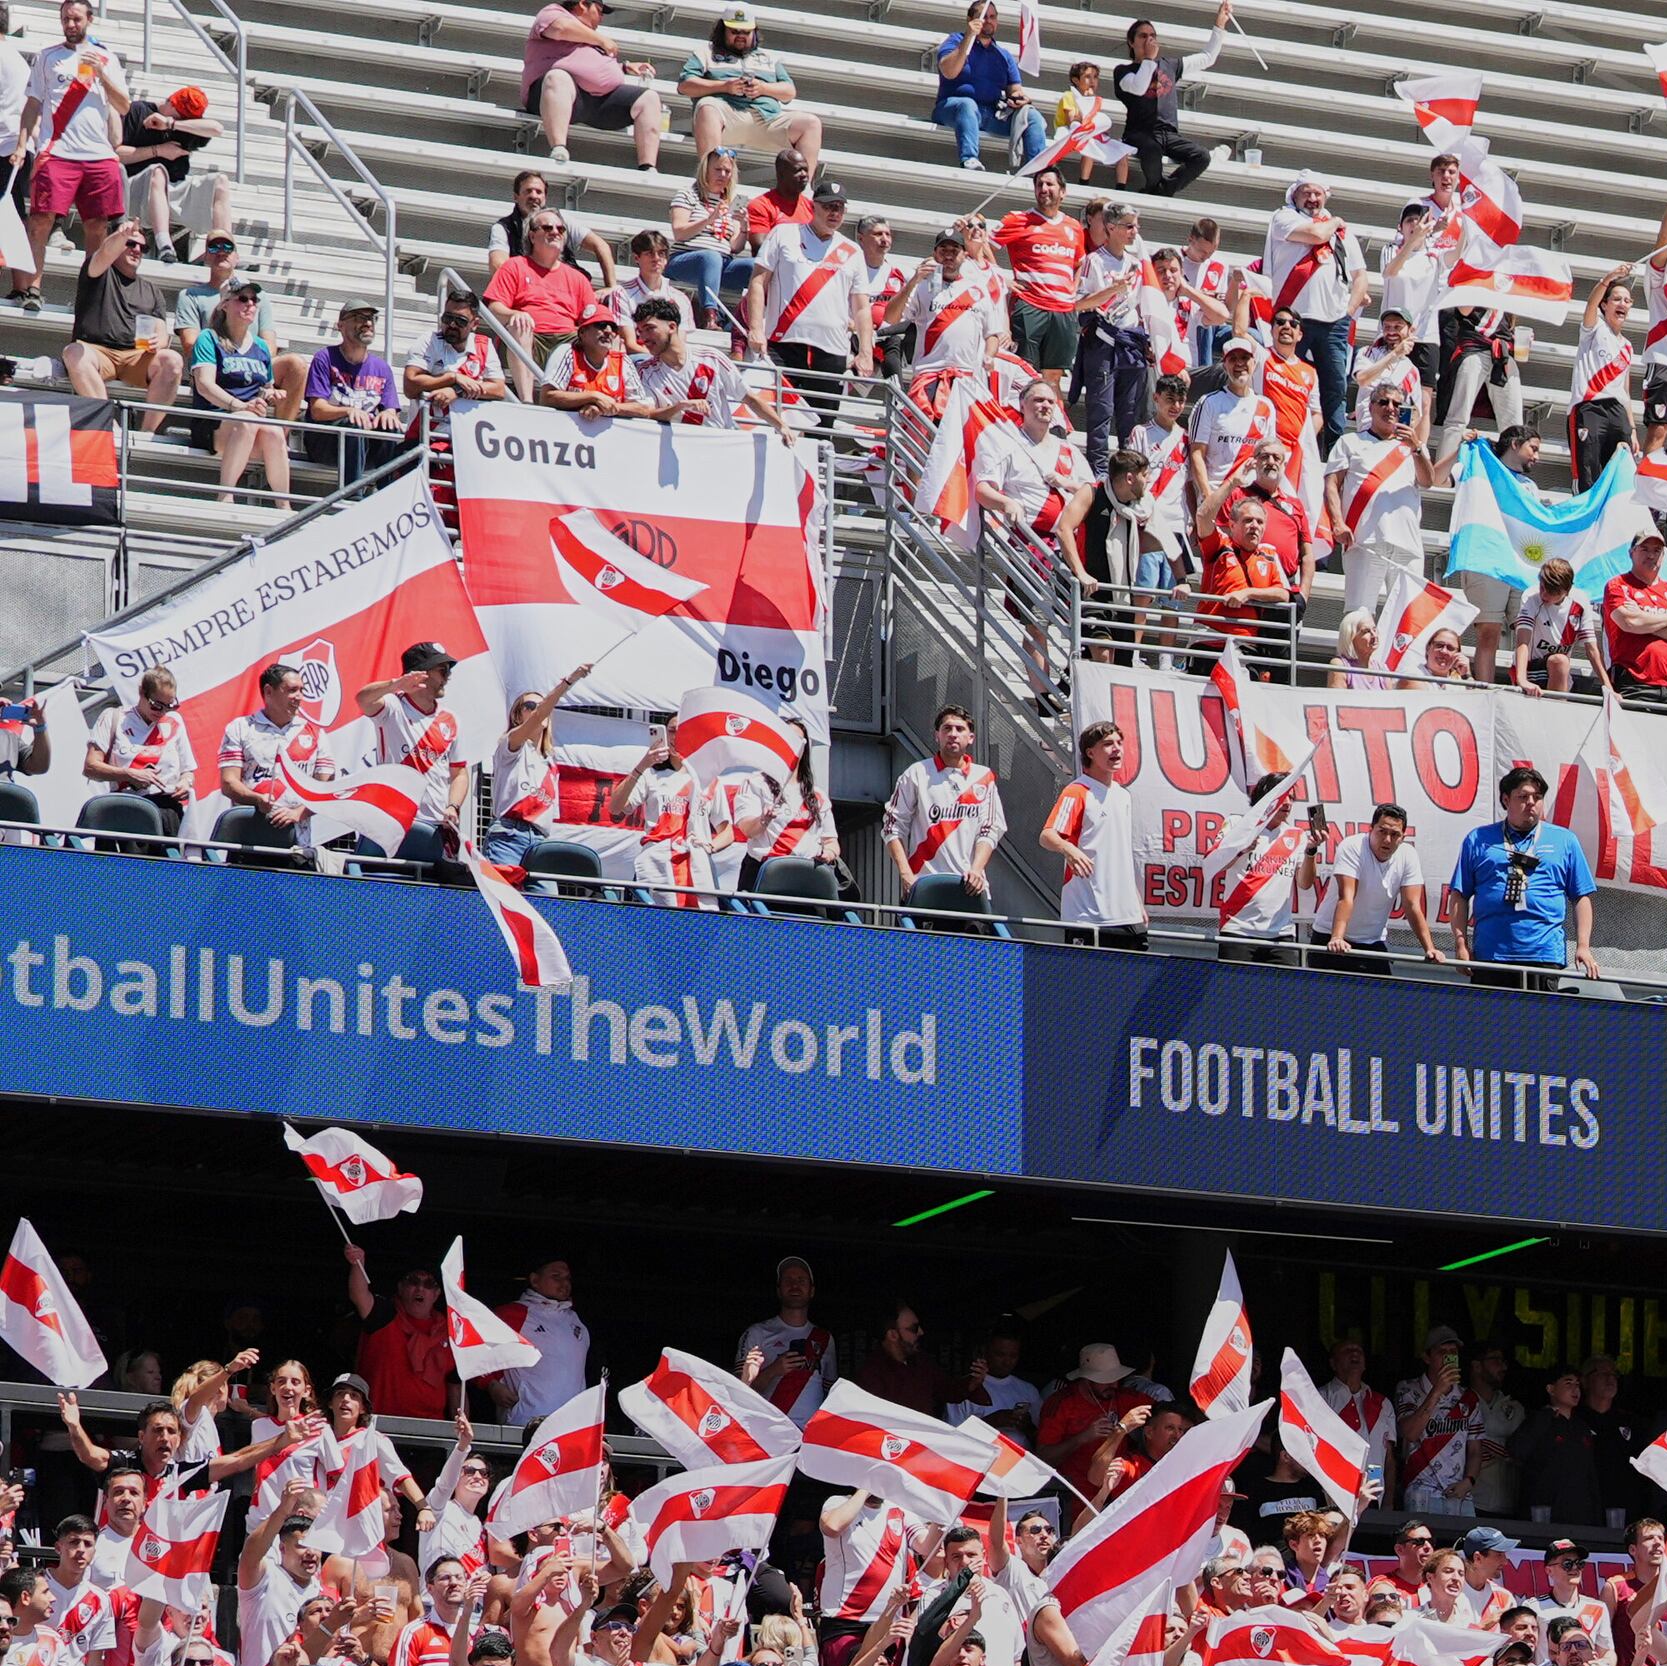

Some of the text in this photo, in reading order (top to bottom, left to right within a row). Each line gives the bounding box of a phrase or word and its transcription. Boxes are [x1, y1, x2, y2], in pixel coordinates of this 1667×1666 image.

[473, 418, 597, 469] Gonza
[257, 499, 432, 624] ESTAREMOS
[114, 597, 255, 679] SIEMPRE
[716, 646, 821, 699] Diego
[930, 802, 980, 824] Quilmes
[1246, 861, 1299, 879] AIRLINES
[1248, 851, 1298, 868] TURKISH
[1128, 1035, 1600, 1150] FOOTBALL UNITES
